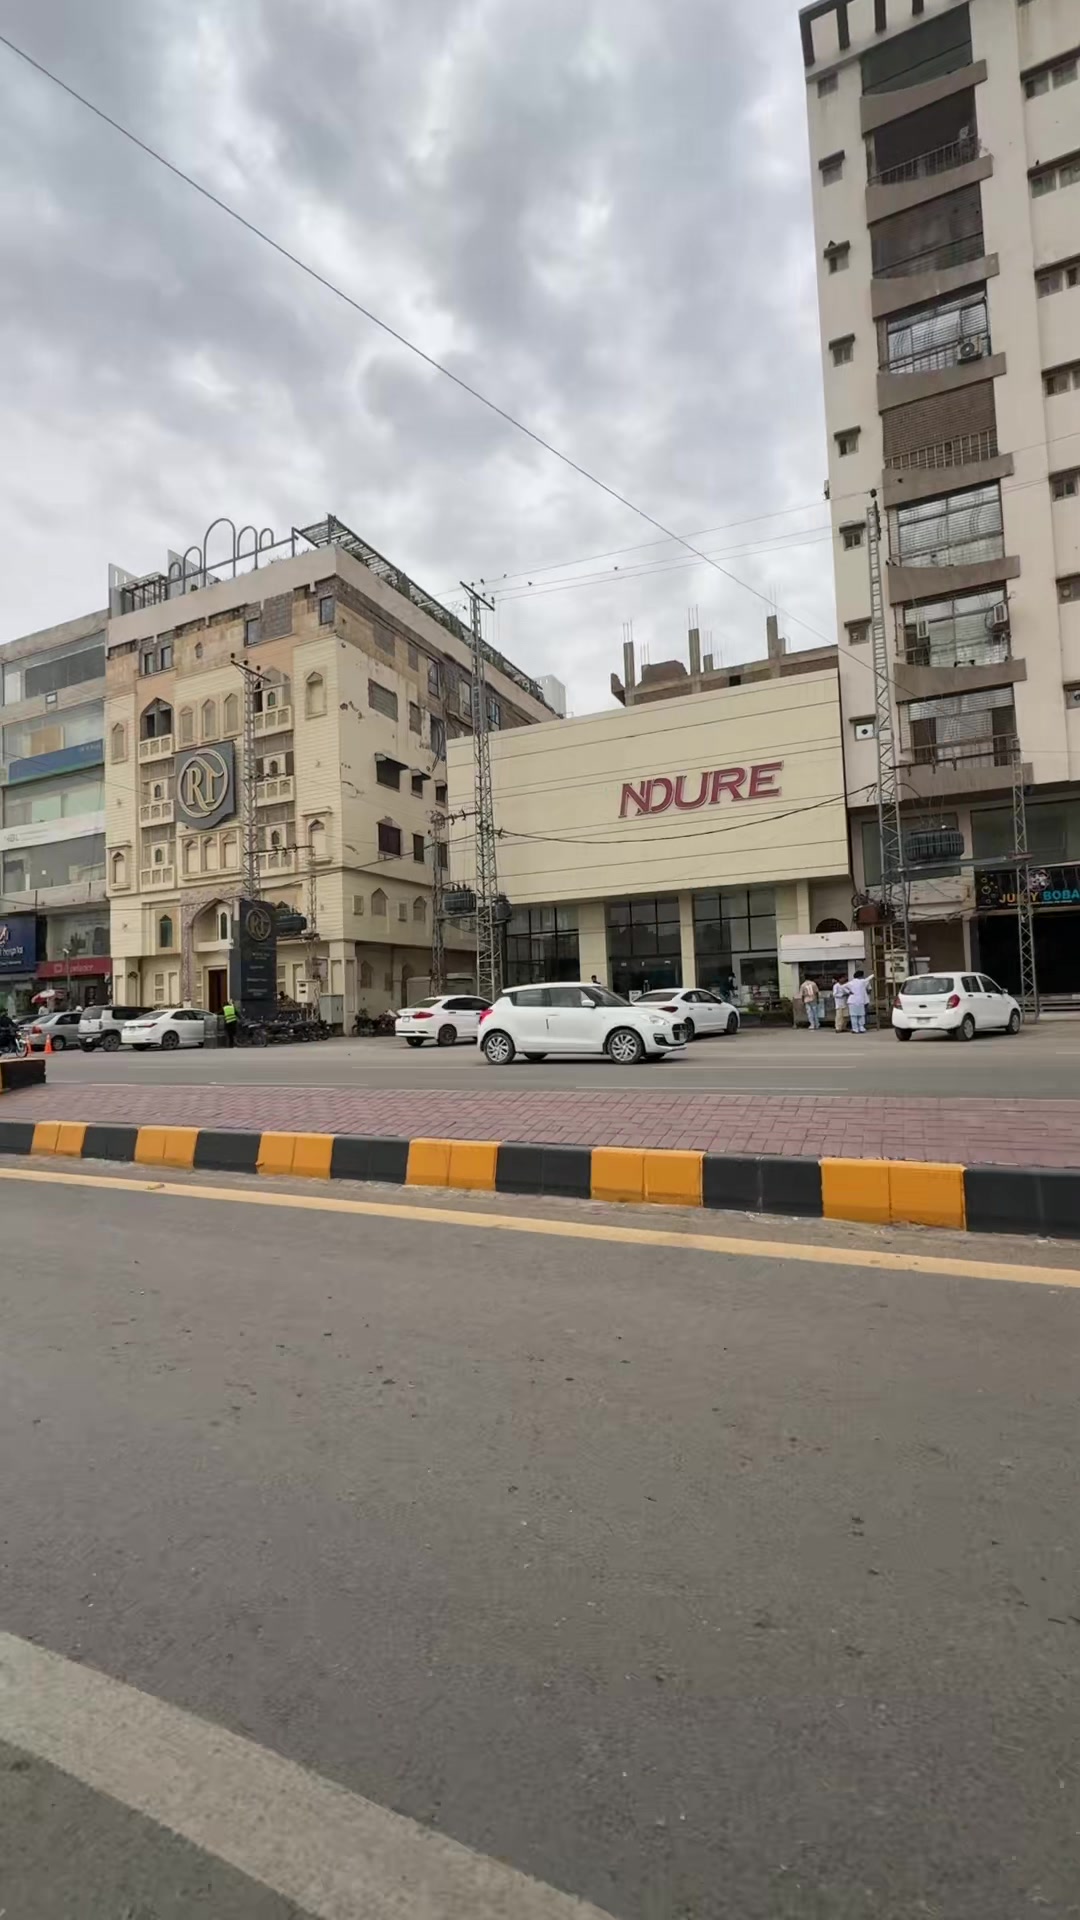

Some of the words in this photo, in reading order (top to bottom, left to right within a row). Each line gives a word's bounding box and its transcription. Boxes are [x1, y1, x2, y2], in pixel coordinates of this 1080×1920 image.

[618, 760, 784, 818] NDURE
[999, 892, 1039, 903] JUY
[1043, 889, 1080, 901] BOBA
